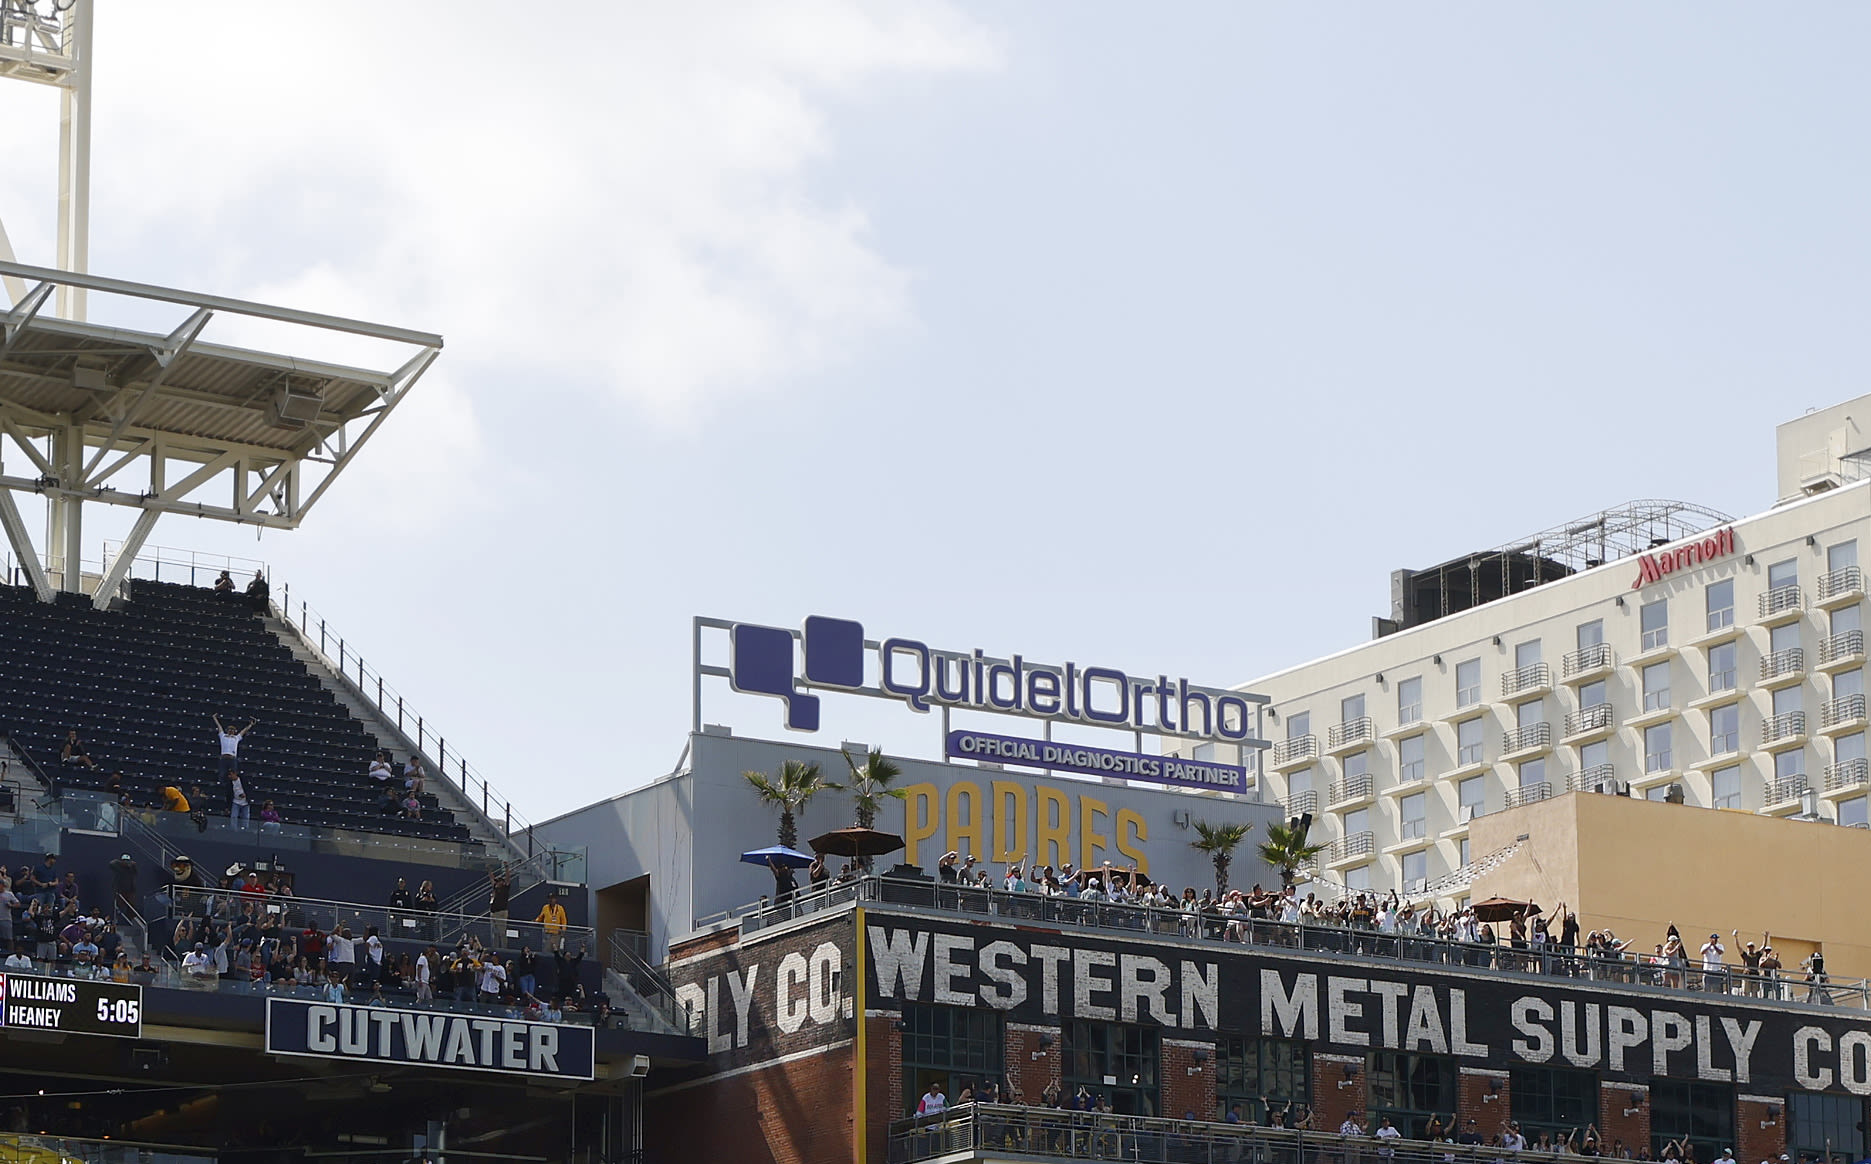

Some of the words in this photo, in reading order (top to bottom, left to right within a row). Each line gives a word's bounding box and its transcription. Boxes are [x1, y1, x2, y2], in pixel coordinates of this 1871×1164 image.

[1631, 526, 1736, 590] Marriott
[879, 636, 1250, 741] QuidelOrtho
[958, 732, 1040, 763] OFFICIAL
[1042, 741, 1161, 778] DIAGNOSTICS
[1162, 762, 1241, 788] PARTNER
[905, 780, 1150, 877] PADRES
[8, 1005, 62, 1028] HEANEY
[9, 978, 77, 1003] WILLIAMS
[97, 997, 139, 1024] 5:05
[776, 941, 854, 1035] CO.
[866, 924, 1219, 1032] WESTERN
[1260, 968, 1490, 1058] METAL
[1510, 995, 1763, 1084] SUPPLY
[307, 1005, 560, 1072] CUTWATER
